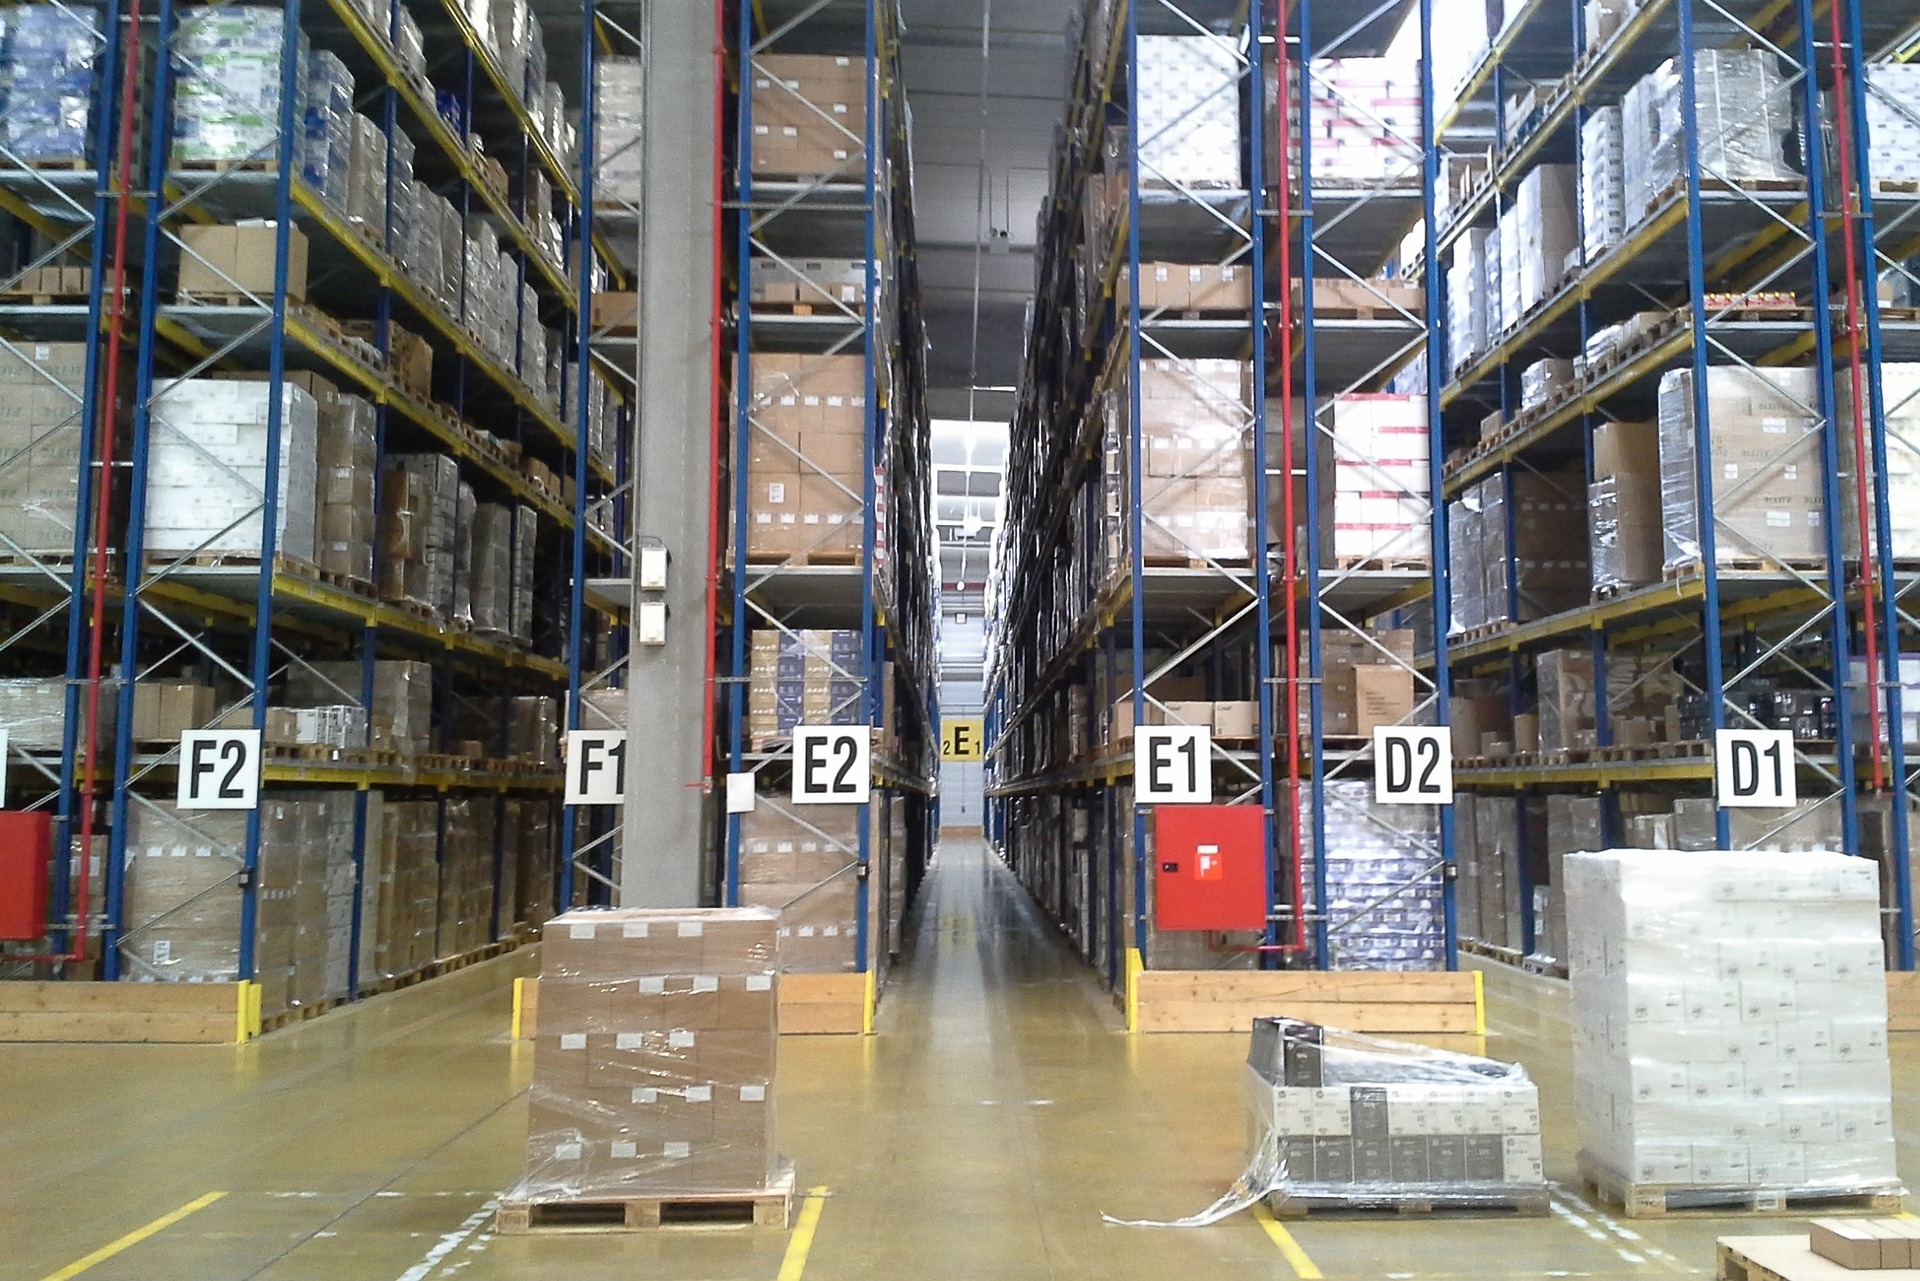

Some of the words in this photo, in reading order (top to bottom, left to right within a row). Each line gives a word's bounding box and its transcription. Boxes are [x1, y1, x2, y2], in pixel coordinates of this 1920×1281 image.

[190, 739, 247, 798] F2
[580, 739, 626, 795] F1
[804, 736, 858, 794] E2
[943, 740, 951, 755] 2
[954, 726, 970, 755] E
[975, 740, 981, 755] 1
[1149, 736, 1196, 793] E1
[1386, 736, 1441, 793] D2
[1731, 739, 1783, 797] D1
